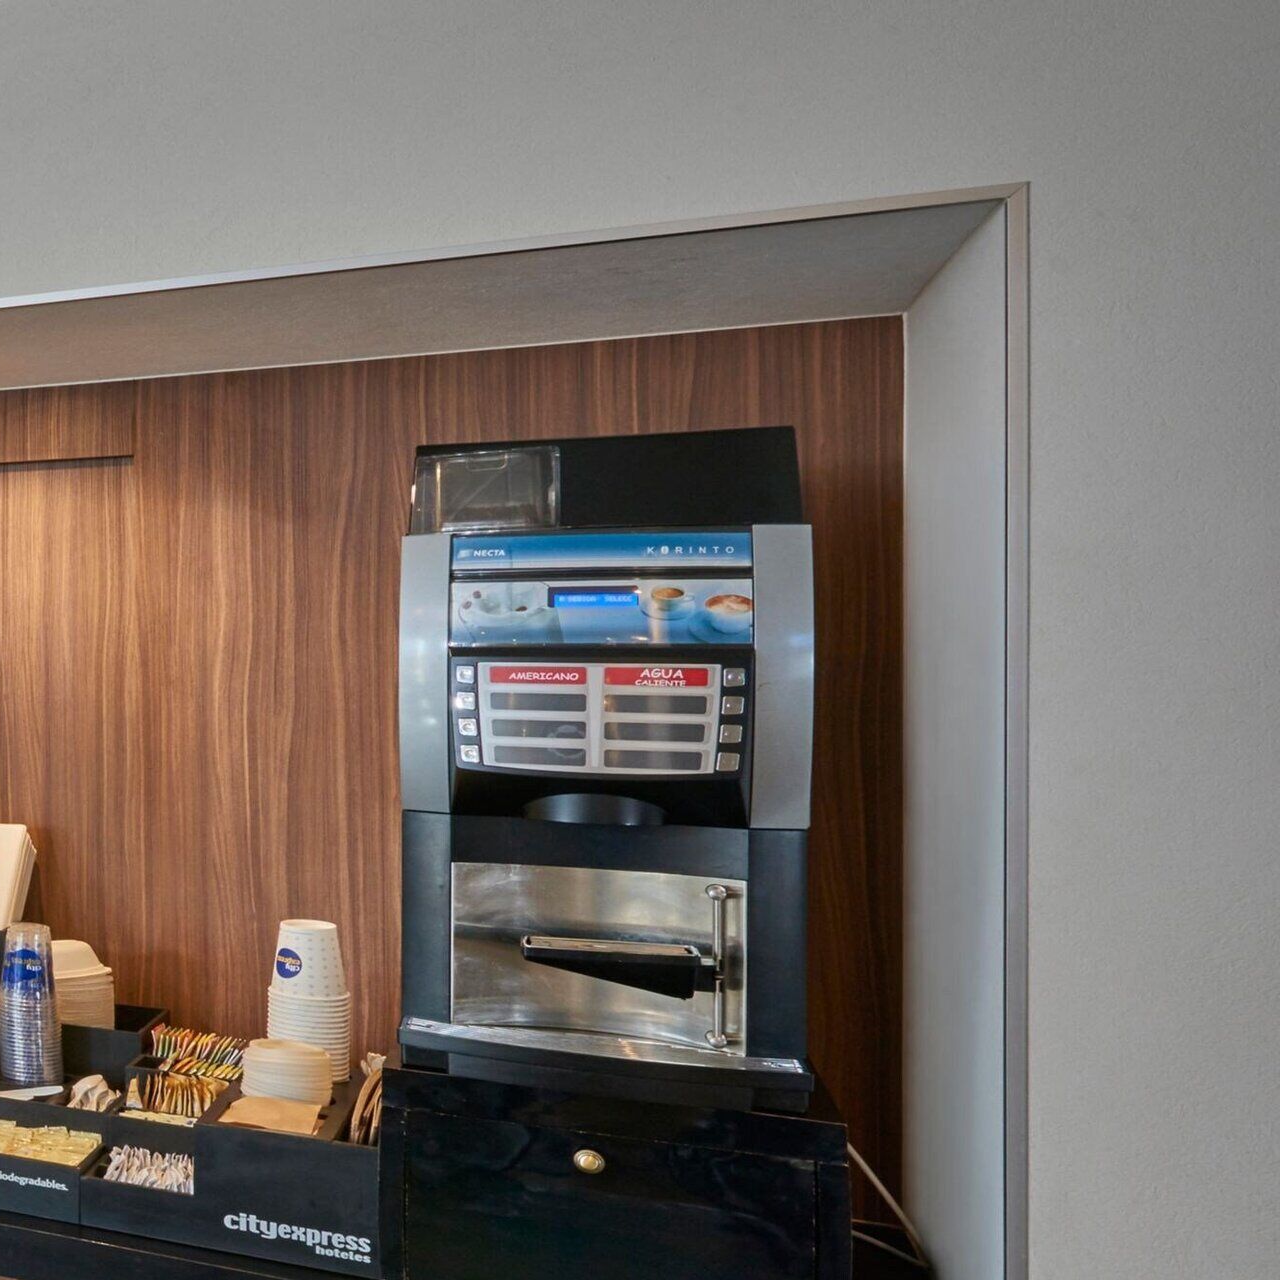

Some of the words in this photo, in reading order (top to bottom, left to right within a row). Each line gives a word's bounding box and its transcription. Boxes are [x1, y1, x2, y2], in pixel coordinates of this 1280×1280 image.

[473, 549, 506, 557] NECTA
[646, 545, 735, 555] KORINTO
[508, 671, 579, 681] AMERICANO
[640, 668, 684, 679] AGUA
[634, 679, 687, 687] CALIENTE
[315, 1245, 371, 1264] hoteles
